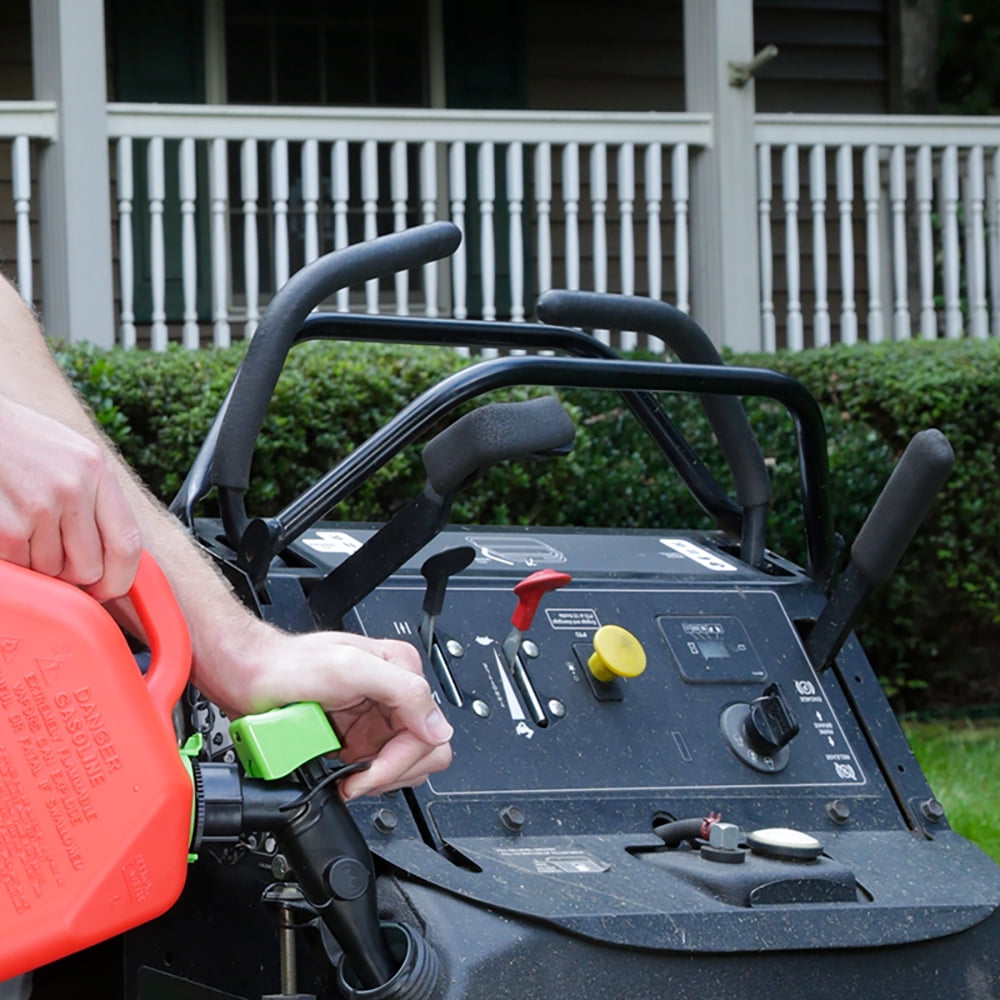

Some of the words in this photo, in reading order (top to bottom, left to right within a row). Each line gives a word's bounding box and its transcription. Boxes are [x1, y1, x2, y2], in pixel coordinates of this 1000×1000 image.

[7, 710, 24, 733] OR
[12, 679, 40, 733] VAPORS
[35, 735, 55, 766] CAN
[49, 768, 83, 827] EXPLODE
[17, 735, 41, 778] FATAL
[23, 671, 64, 742] EXTREMELY
[57, 746, 98, 823] FLAMMABLE
[53, 690, 106, 788] GASOLINE
[72, 685, 122, 774] DANGER
[37, 778, 52, 791] IF
[44, 796, 84, 872] SWALLOWED
